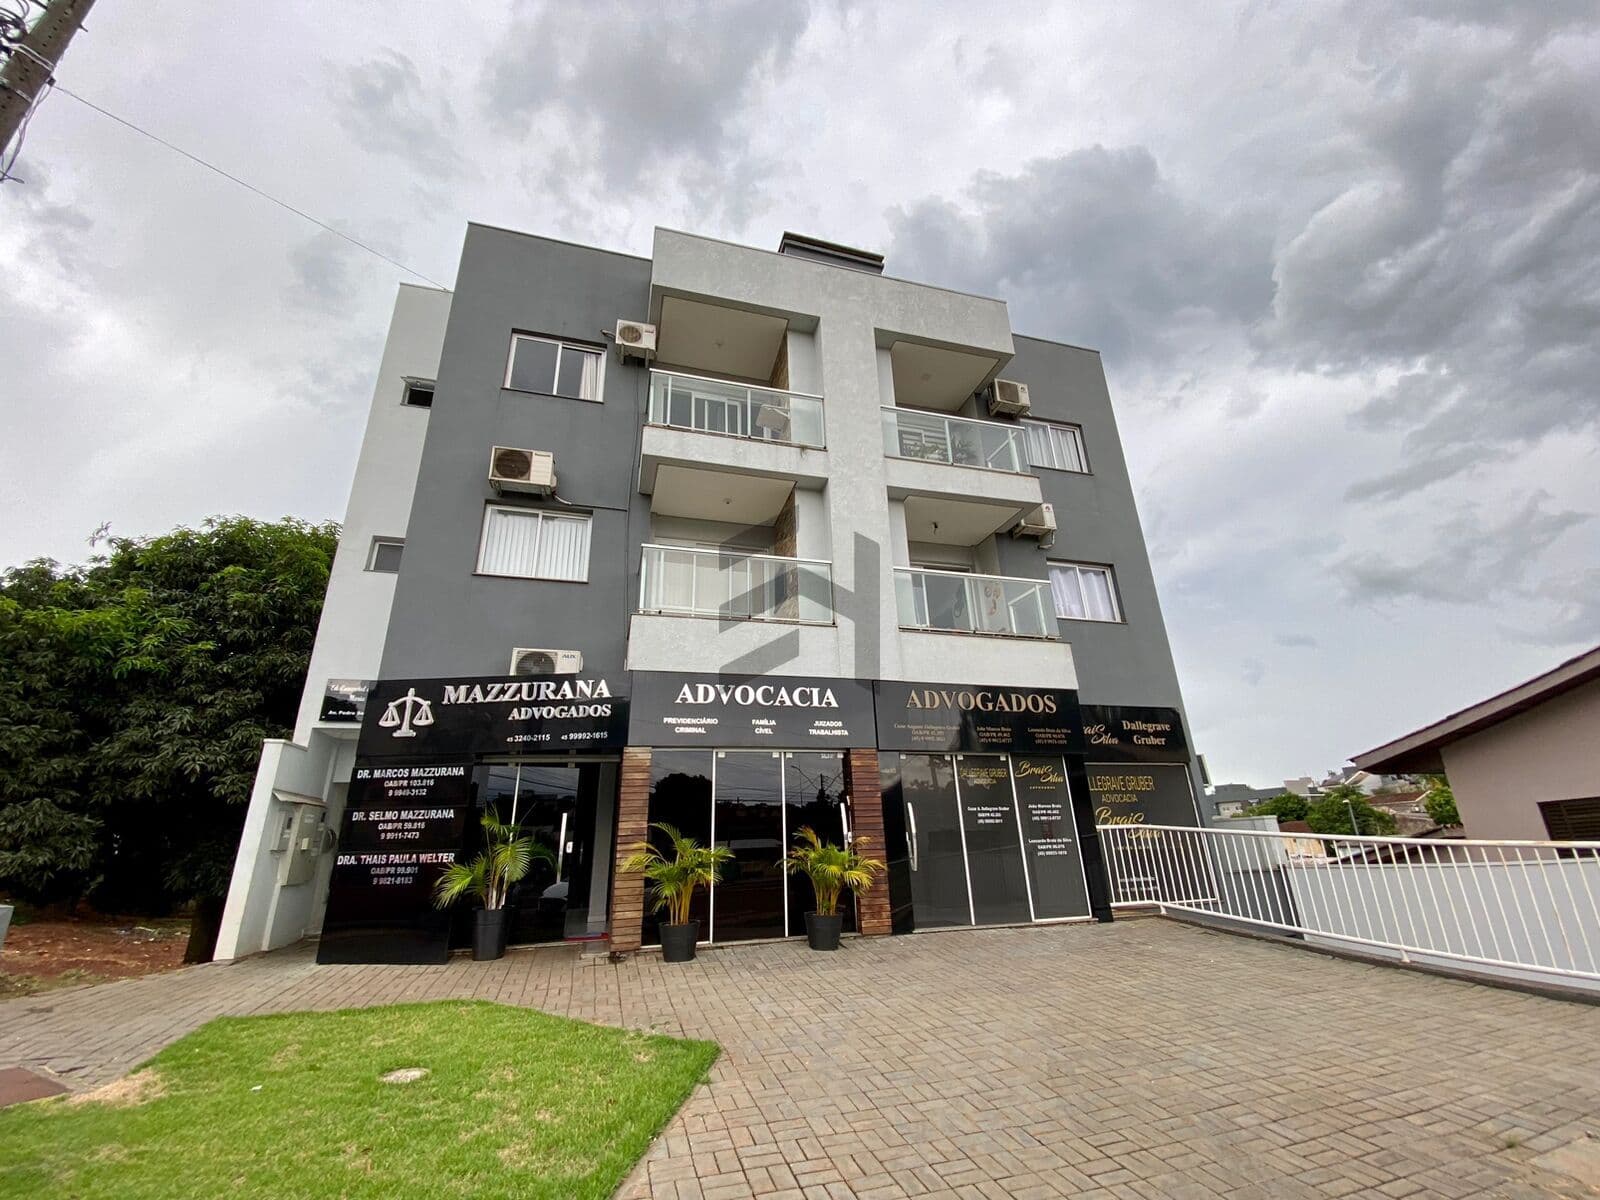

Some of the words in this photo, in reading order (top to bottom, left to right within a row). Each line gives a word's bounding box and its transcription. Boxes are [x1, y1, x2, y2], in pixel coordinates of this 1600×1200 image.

[441, 679, 612, 705] MAZZURANA
[674, 683, 839, 708] ADVOCACIA
[906, 689, 1057, 714] ADVOGADOS
[507, 703, 612, 721] ADVOGADOS
[663, 717, 719, 725] PREVIDENCIÁRIO
[751, 718, 777, 726] FAMÍLIA
[1121, 719, 1172, 733] Dallegrave
[568, 731, 608, 741] 99992-1615
[674, 726, 707, 734] CRIMINAL
[754, 726, 774, 735] CÍVEL
[808, 728, 849, 736] TRABALHISTA
[514, 734, 551, 742] 3240-2115
[1133, 734, 1167, 746] Gruber
[356, 769, 371, 779] DR.
[373, 768, 410, 778] MARCOS
[410, 766, 465, 777] MAZZURANA
[1087, 776, 1124, 791] LLEGRAVE
[1125, 776, 1155, 791] GRUBER
[1101, 793, 1138, 803] ADVOCACIA
[352, 811, 367, 821] DR.
[368, 810, 399, 821] SELMO
[400, 808, 455, 820] MAZZURANA
[337, 855, 358, 865] DRA.
[360, 854, 388, 865] THAIS
[388, 853, 417, 864] PAULA
[419, 852, 455, 864] WELTER
